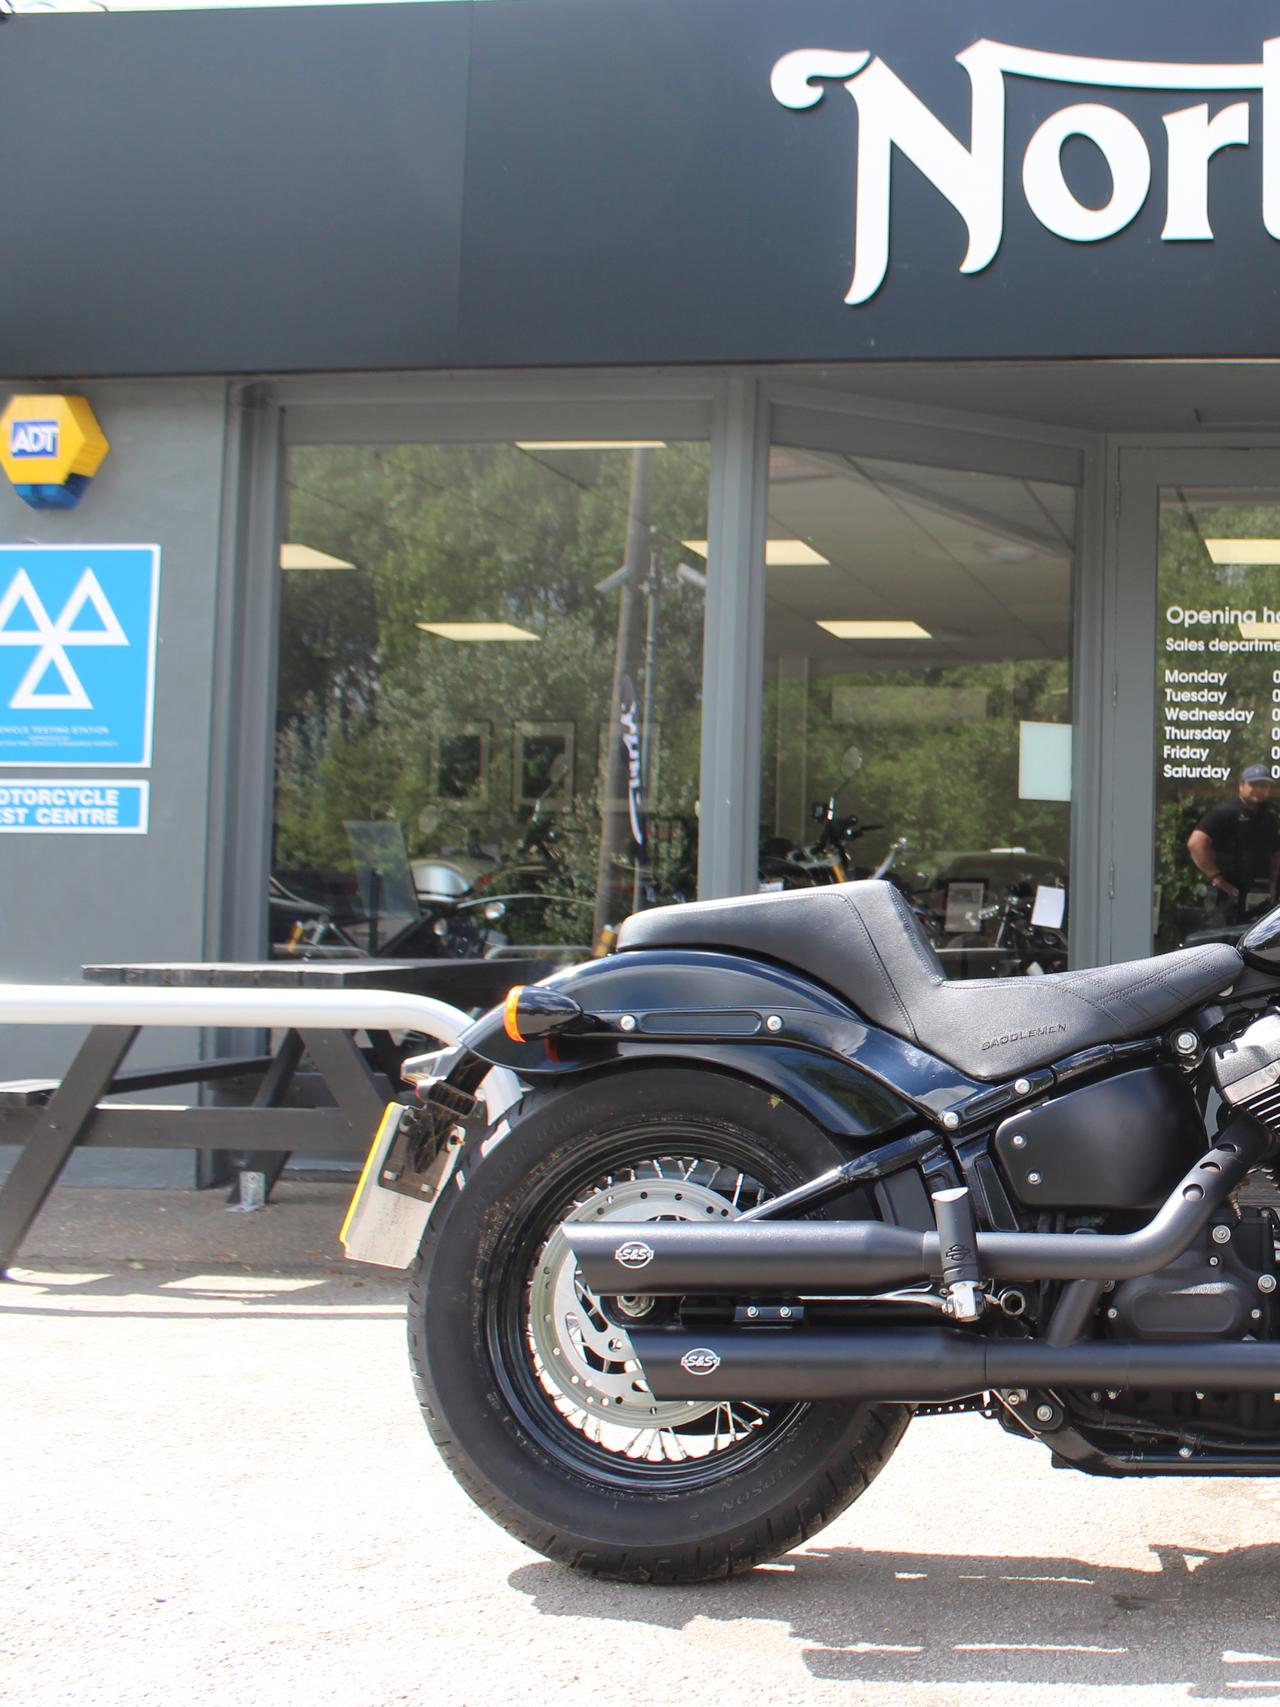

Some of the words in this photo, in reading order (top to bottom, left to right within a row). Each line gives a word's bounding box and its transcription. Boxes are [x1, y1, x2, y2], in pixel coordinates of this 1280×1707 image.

[12, 423, 60, 453] ADT
[1166, 605, 1257, 628] Opening
[1166, 637, 1205, 652] Sales
[1165, 670, 1228, 686] Monday
[1165, 689, 1227, 705] Tuesday
[1165, 708, 1254, 724] Wednesday
[1165, 726, 1231, 742] Thursday
[1163, 746, 1209, 762] Friday
[1163, 765, 1231, 781] Saturday
[0, 788, 119, 806] OTORCYCLE
[0, 807, 29, 825] ST
[35, 807, 119, 825] CENTRE
[981, 1023, 1067, 1051] SADDLEMEN
